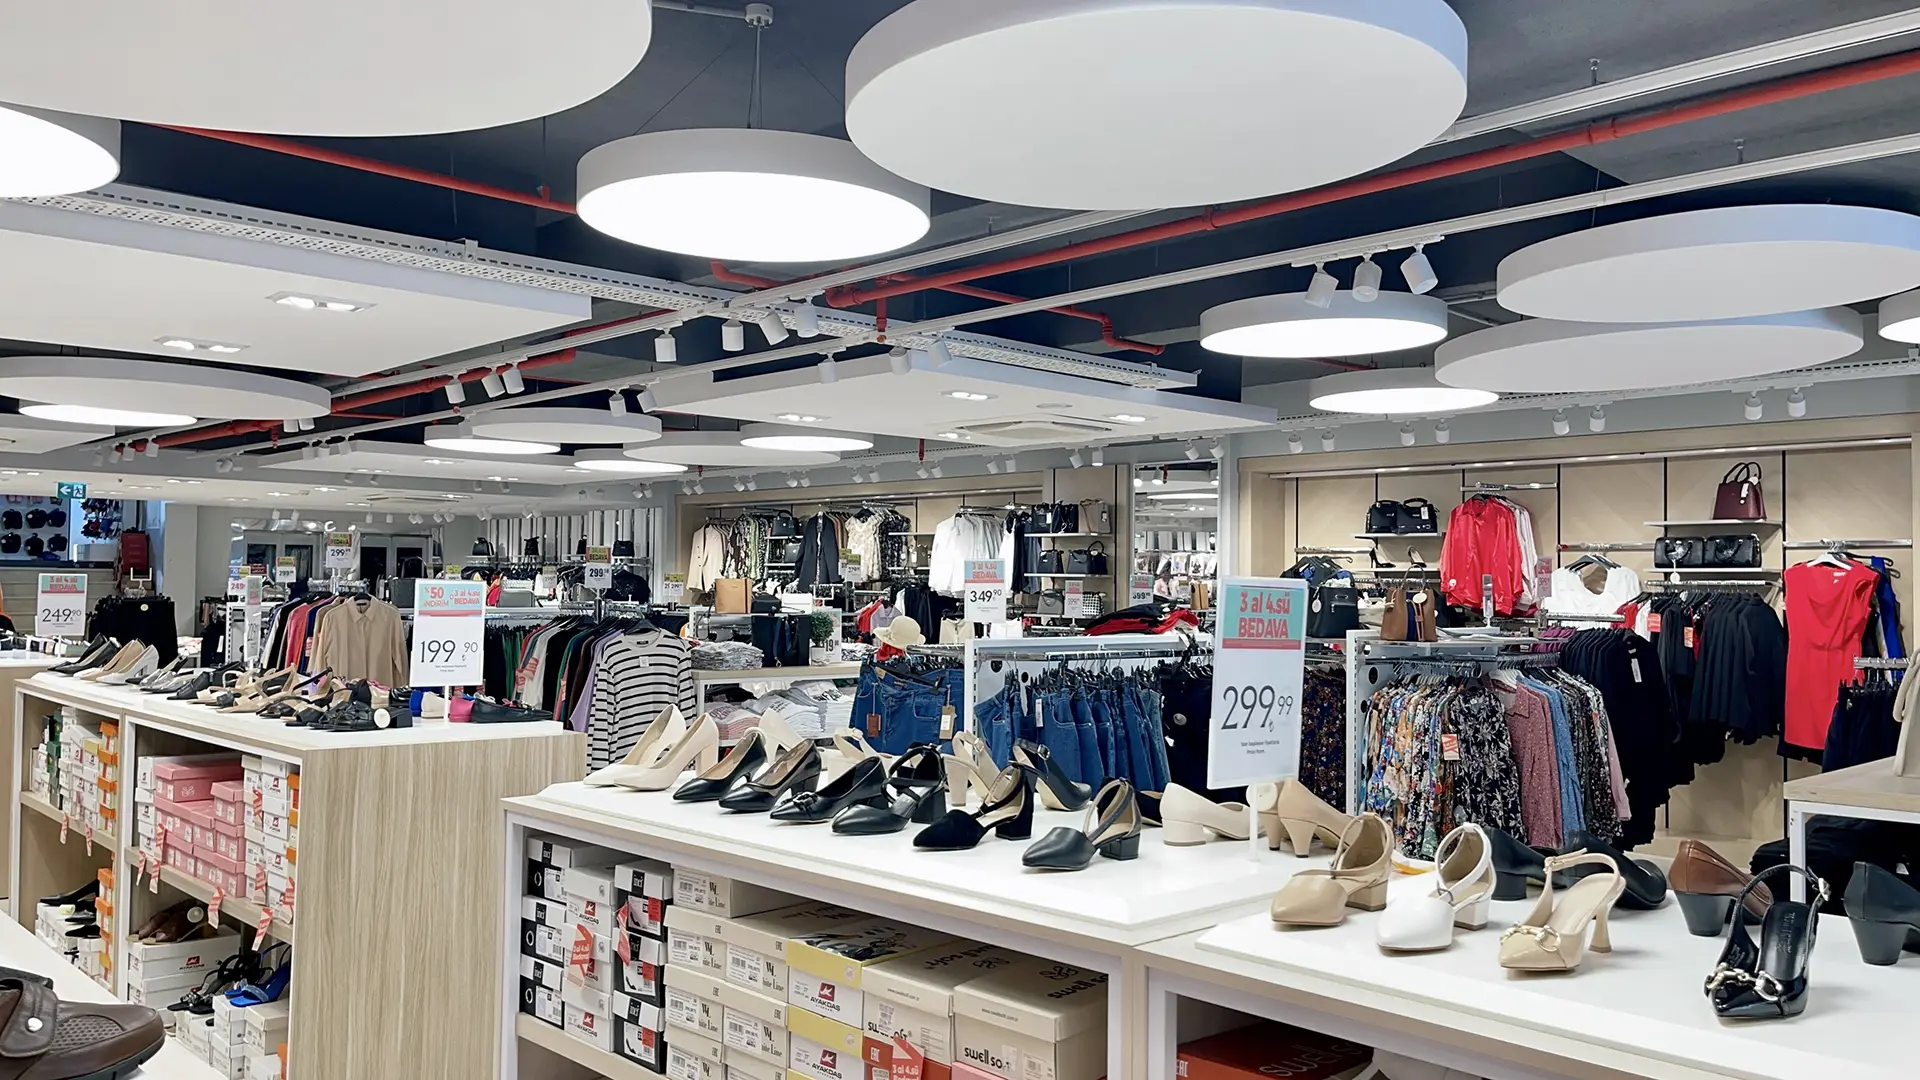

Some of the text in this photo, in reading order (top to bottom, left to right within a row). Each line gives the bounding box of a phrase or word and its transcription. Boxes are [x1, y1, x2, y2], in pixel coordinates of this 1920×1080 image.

[330, 549, 345, 557] 299
[589, 568, 604, 578] 299
[970, 590, 993, 602] 349
[1240, 591, 1248, 612] 3
[1251, 591, 1264, 613] al
[42, 608, 72, 622] 249
[1238, 617, 1289, 639] BEDAVA
[420, 640, 456, 663] 199
[463, 642, 478, 653] 90
[1221, 685, 1276, 730] 299
[1277, 695, 1293, 715] 99
[964, 1047, 989, 1065] swell
